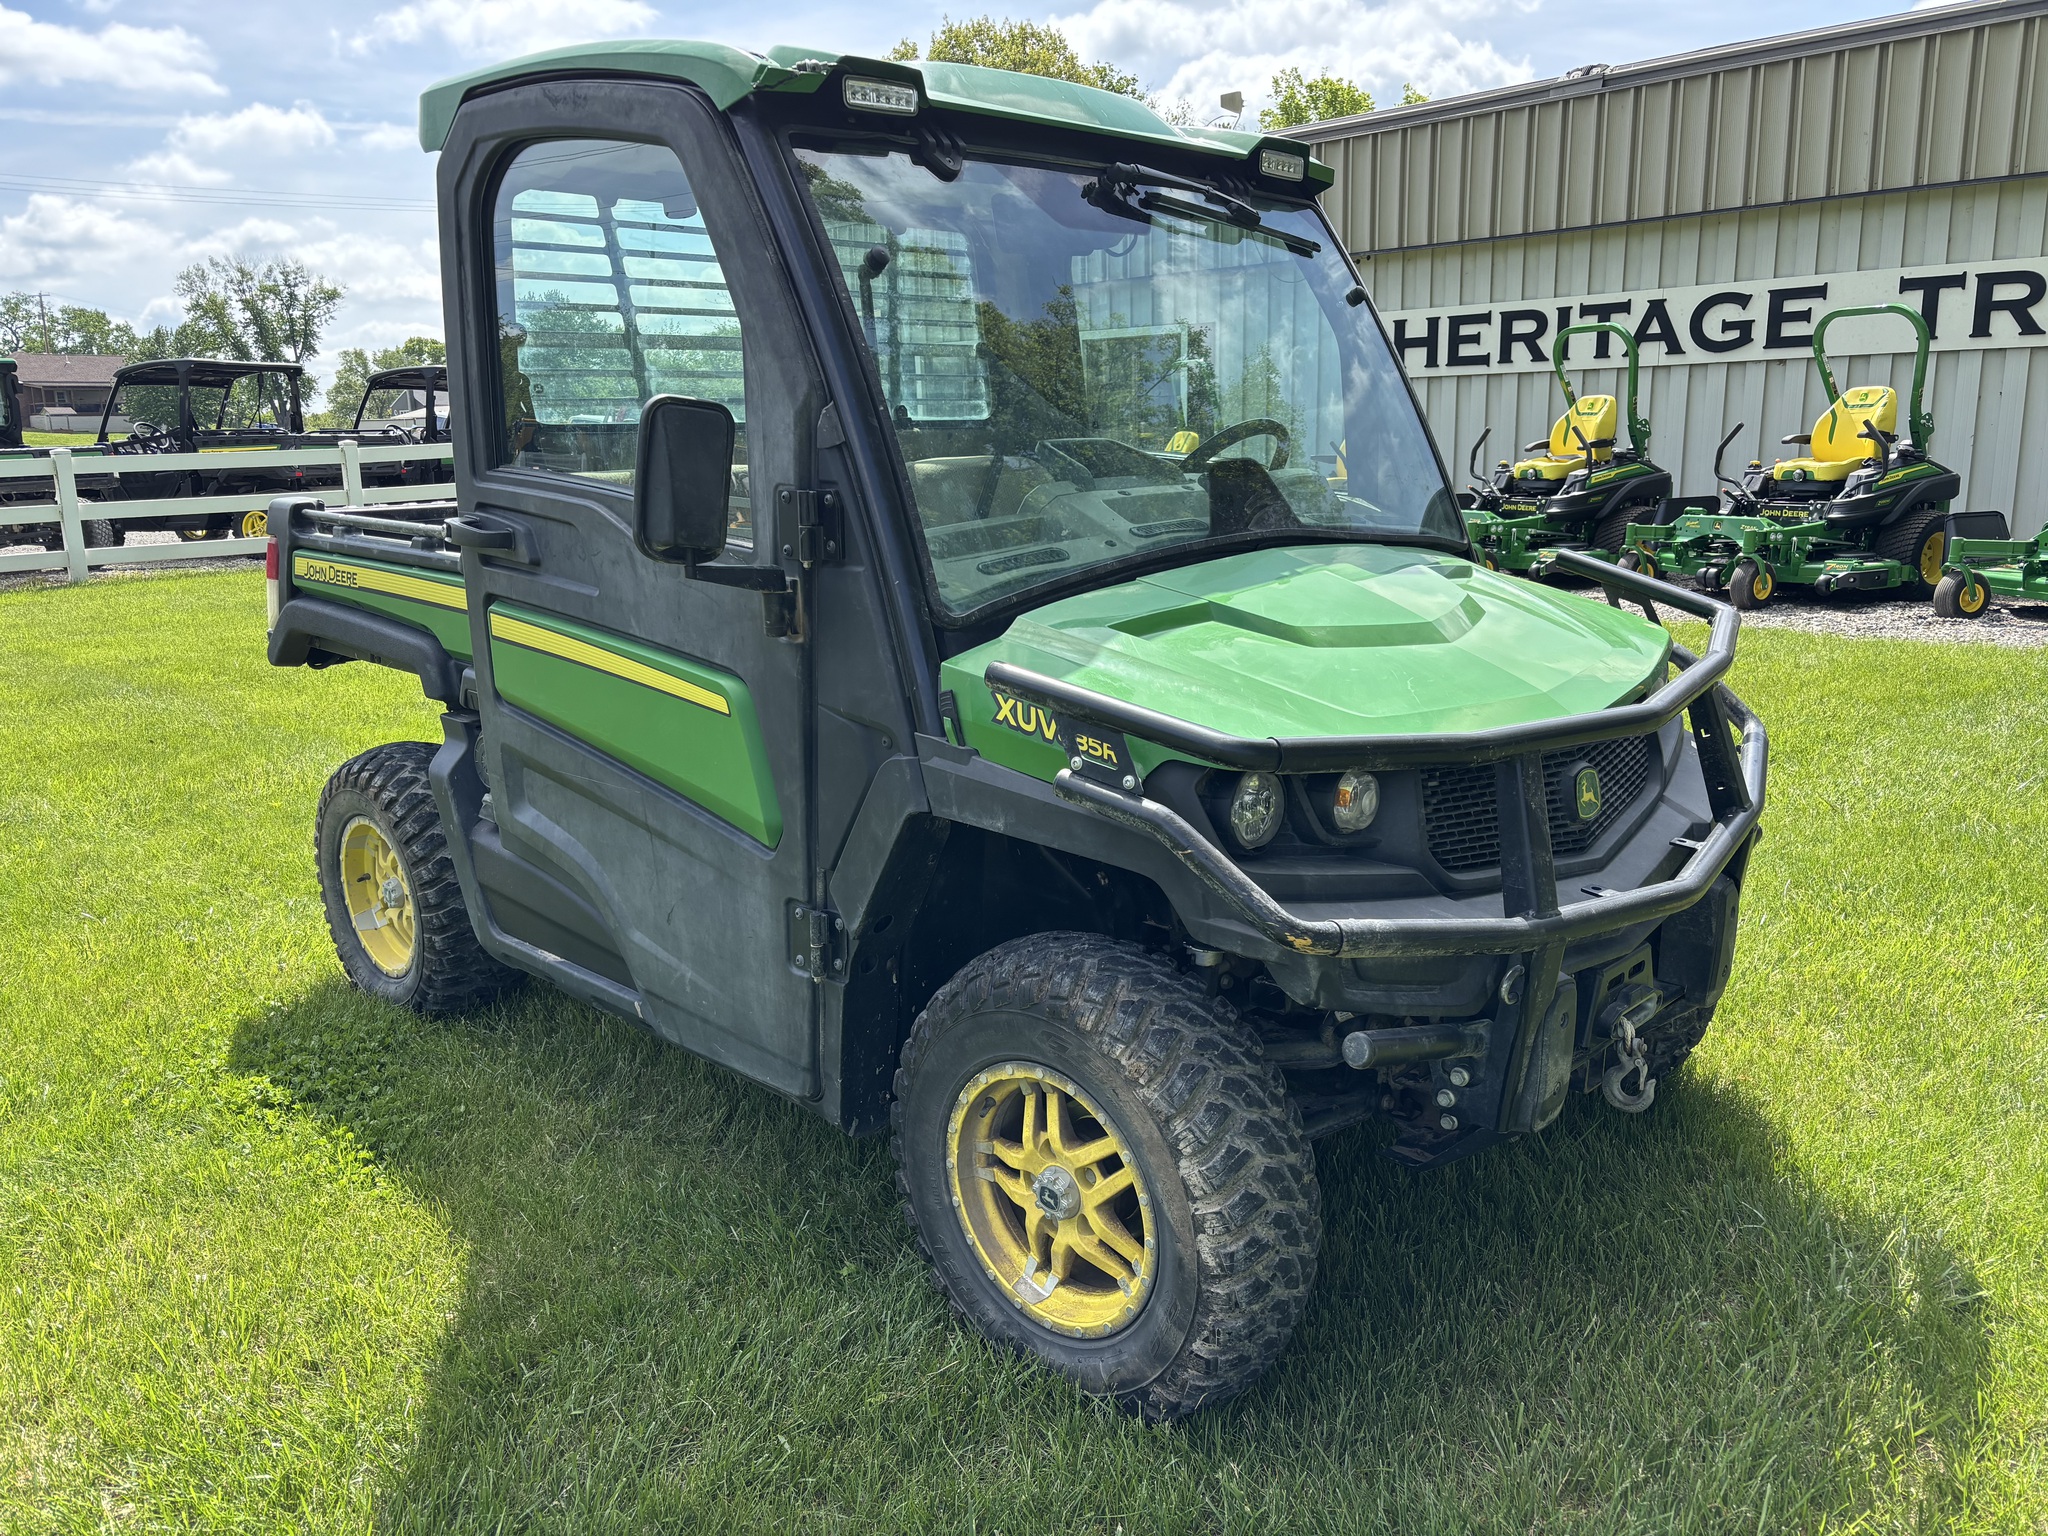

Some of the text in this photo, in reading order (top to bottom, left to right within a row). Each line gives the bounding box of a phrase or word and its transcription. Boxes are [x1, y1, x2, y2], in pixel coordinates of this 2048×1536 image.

[1393, 281, 1828, 368] HERITAGE
[1501, 503, 1537, 512] JOHN DEERE
[1760, 508, 1809, 518] JOHN DEERE
[303, 561, 358, 586] JOHN DEERE
